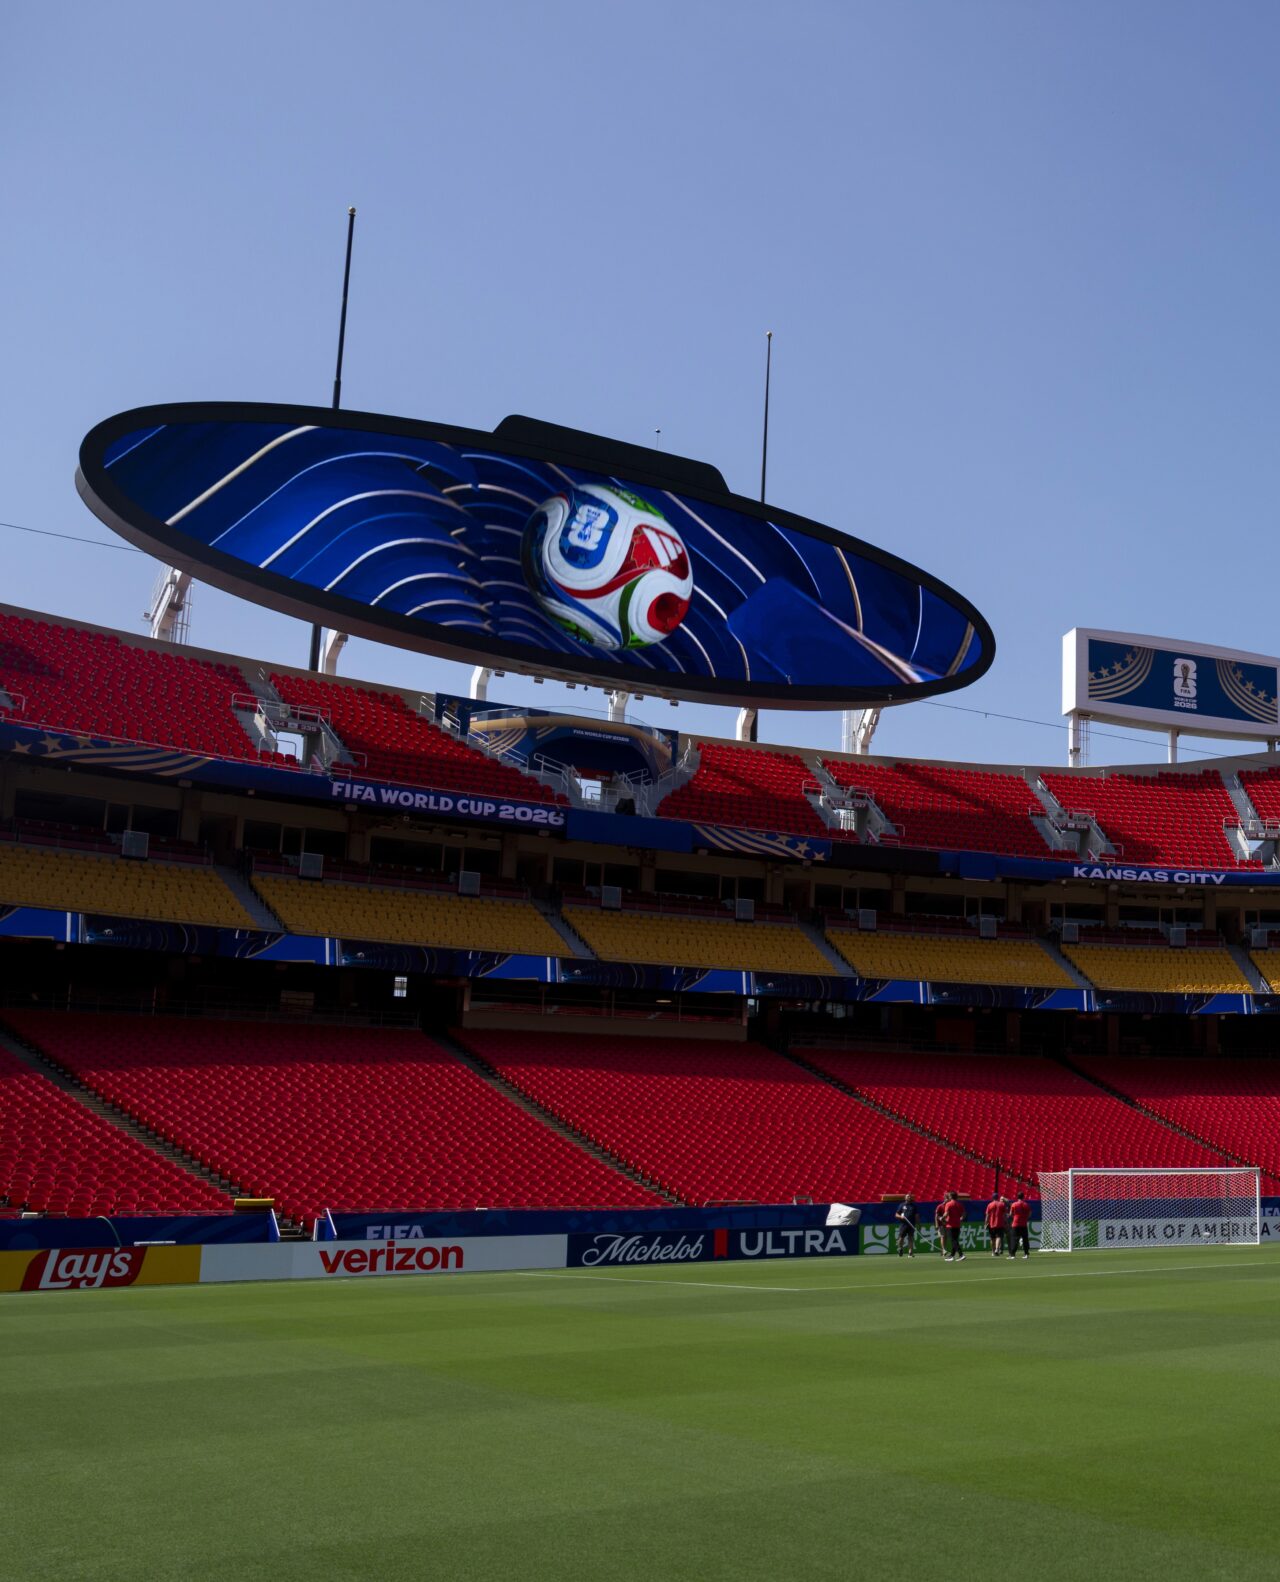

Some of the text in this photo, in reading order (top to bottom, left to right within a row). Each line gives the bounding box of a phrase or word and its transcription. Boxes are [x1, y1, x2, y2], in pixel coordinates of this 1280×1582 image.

[1174, 700, 1198, 710] 2026
[332, 781, 565, 826] FIFA WORLD CUP 2026
[1073, 866, 1226, 885] KANSAS CITY
[366, 1225, 425, 1240] FIFA
[1105, 1222, 1157, 1241] BANK
[1163, 1222, 1186, 1240] OF
[1191, 1220, 1271, 1239] AMERICA
[319, 1240, 464, 1274] verizon
[581, 1229, 847, 1266] Michelob ULTRA
[38, 1248, 132, 1289] Lay's
